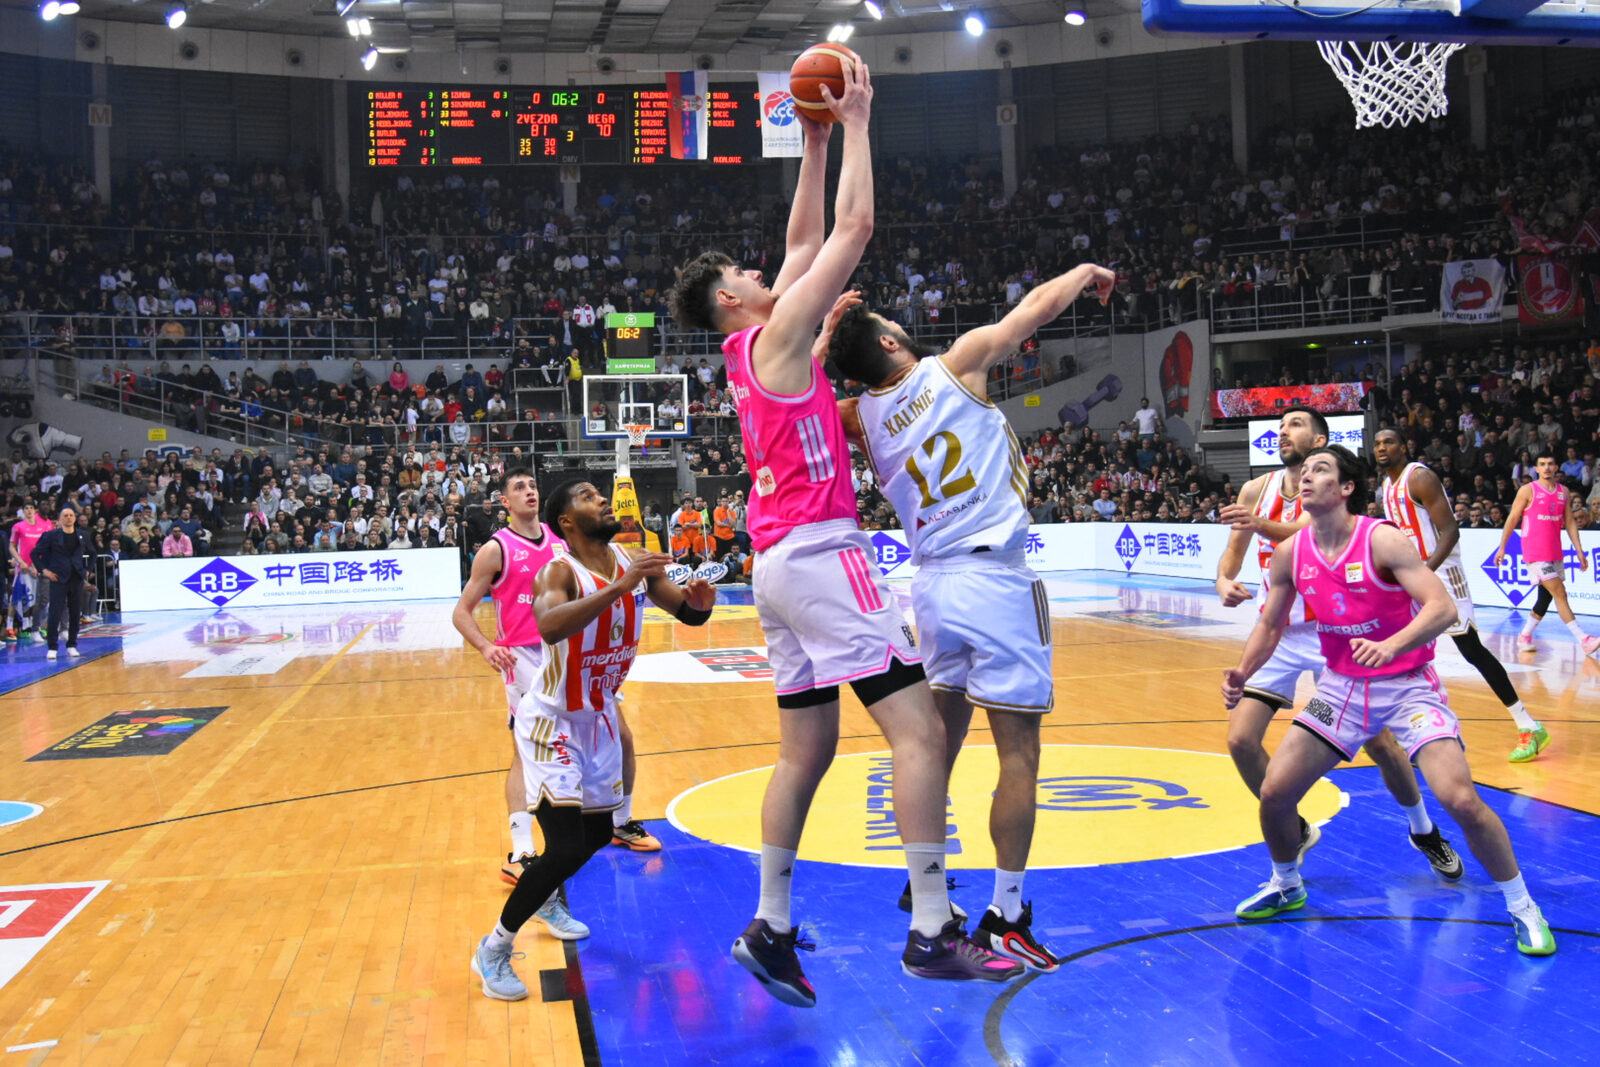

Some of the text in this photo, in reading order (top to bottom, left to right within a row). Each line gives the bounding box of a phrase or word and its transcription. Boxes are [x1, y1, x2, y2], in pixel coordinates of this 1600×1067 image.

[428, 91, 434, 99] 3
[493, 91, 502, 99] 10
[503, 91, 508, 99] 3
[533, 92, 541, 104] 0
[551, 92, 579, 106] 06:2
[597, 92, 606, 104] 0
[90, 106, 110, 124] M
[369, 110, 374, 118] 2
[440, 110, 449, 118] 33
[370, 129, 375, 137] 6
[429, 129, 435, 137] 3
[530, 124, 548, 137] 81
[596, 124, 612, 137] 70
[566, 130, 574, 142] 3
[519, 138, 556, 147] 35 30
[430, 147, 436, 155] 3
[519, 147, 556, 156] 25 25
[616, 327, 640, 339] 06:2
[882, 386, 936, 437] KALINIĆ
[905, 431, 978, 509] 12
[927, 493, 988, 524] ALTABANKA
[1143, 532, 1202, 558] 中国路桥
[263, 558, 403, 587] 中国路桥
[1331, 592, 1347, 616] 3
[609, 617, 624, 641] 6
[1316, 618, 1381, 636] UPERBET
[1428, 708, 1446, 728] 3
[76, 723, 149, 749] SPIN
